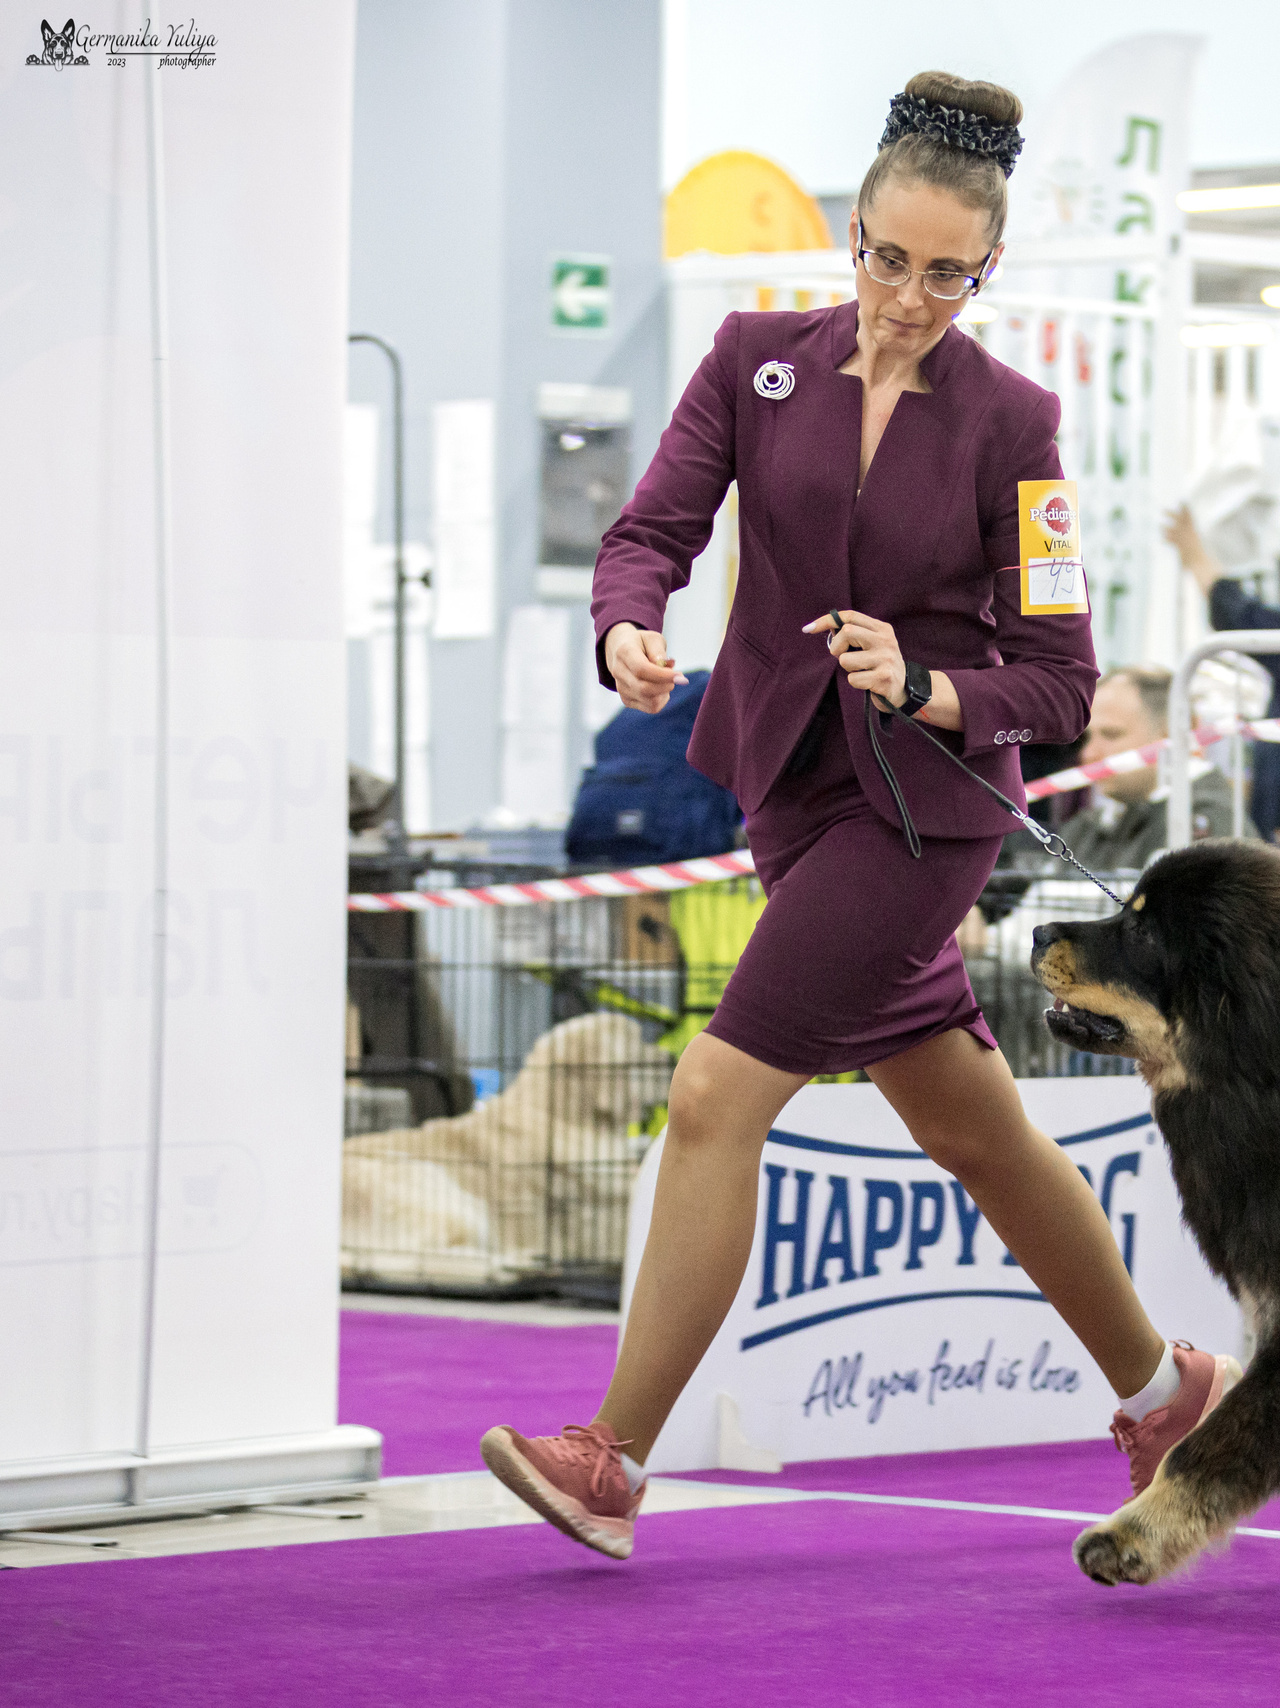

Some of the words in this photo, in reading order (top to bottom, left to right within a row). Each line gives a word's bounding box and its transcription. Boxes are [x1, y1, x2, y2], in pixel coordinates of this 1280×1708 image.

[1029, 507, 1077, 522] Pedigree
[755, 1162, 980, 1309] HAPPY
[801, 1351, 863, 1418] All
[867, 1368, 919, 1424] you
[927, 1338, 994, 1405] feed
[996, 1356, 1022, 1390] is
[1028, 1340, 1082, 1393] love
